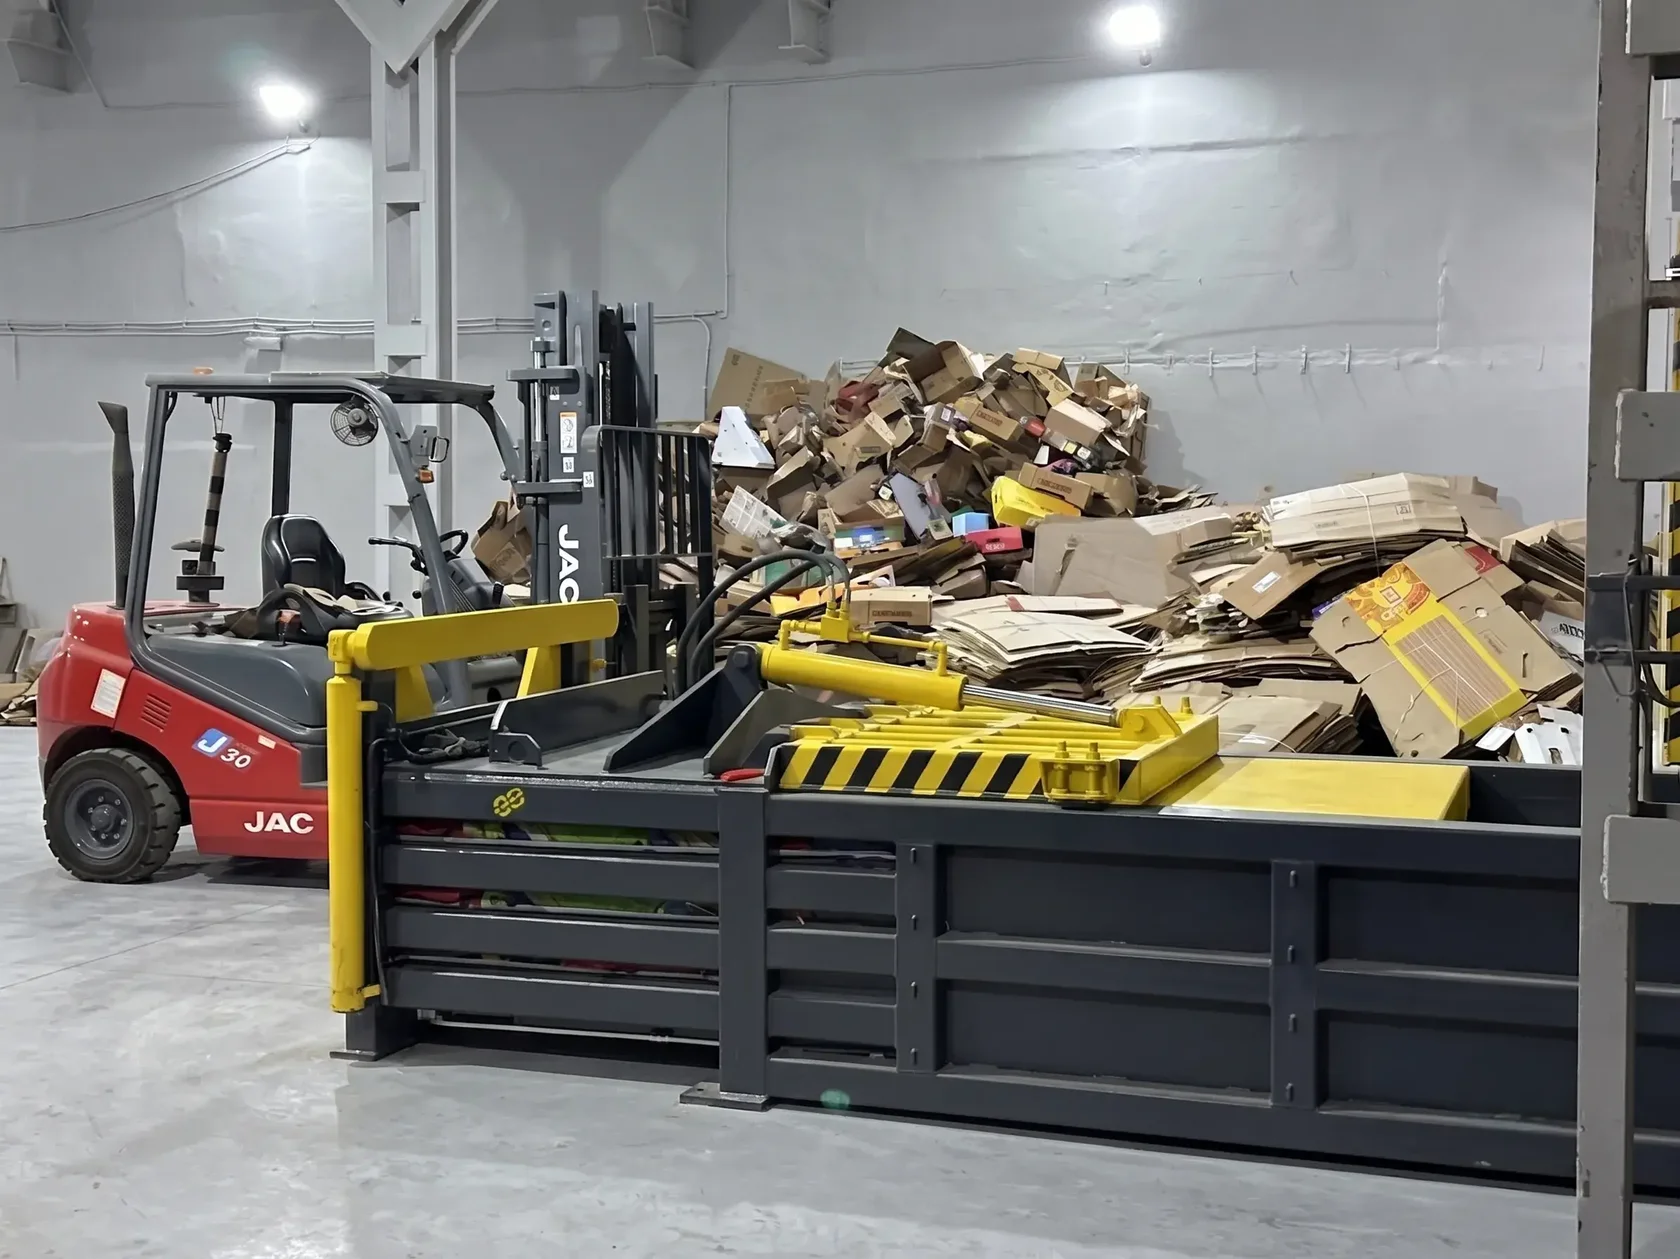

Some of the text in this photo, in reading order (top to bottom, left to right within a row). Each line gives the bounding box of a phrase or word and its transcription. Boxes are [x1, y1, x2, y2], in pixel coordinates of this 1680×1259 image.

[559, 524, 580, 603] JAC
[197, 736, 228, 753] J
[220, 748, 252, 768] 30
[244, 811, 314, 834] JAC
